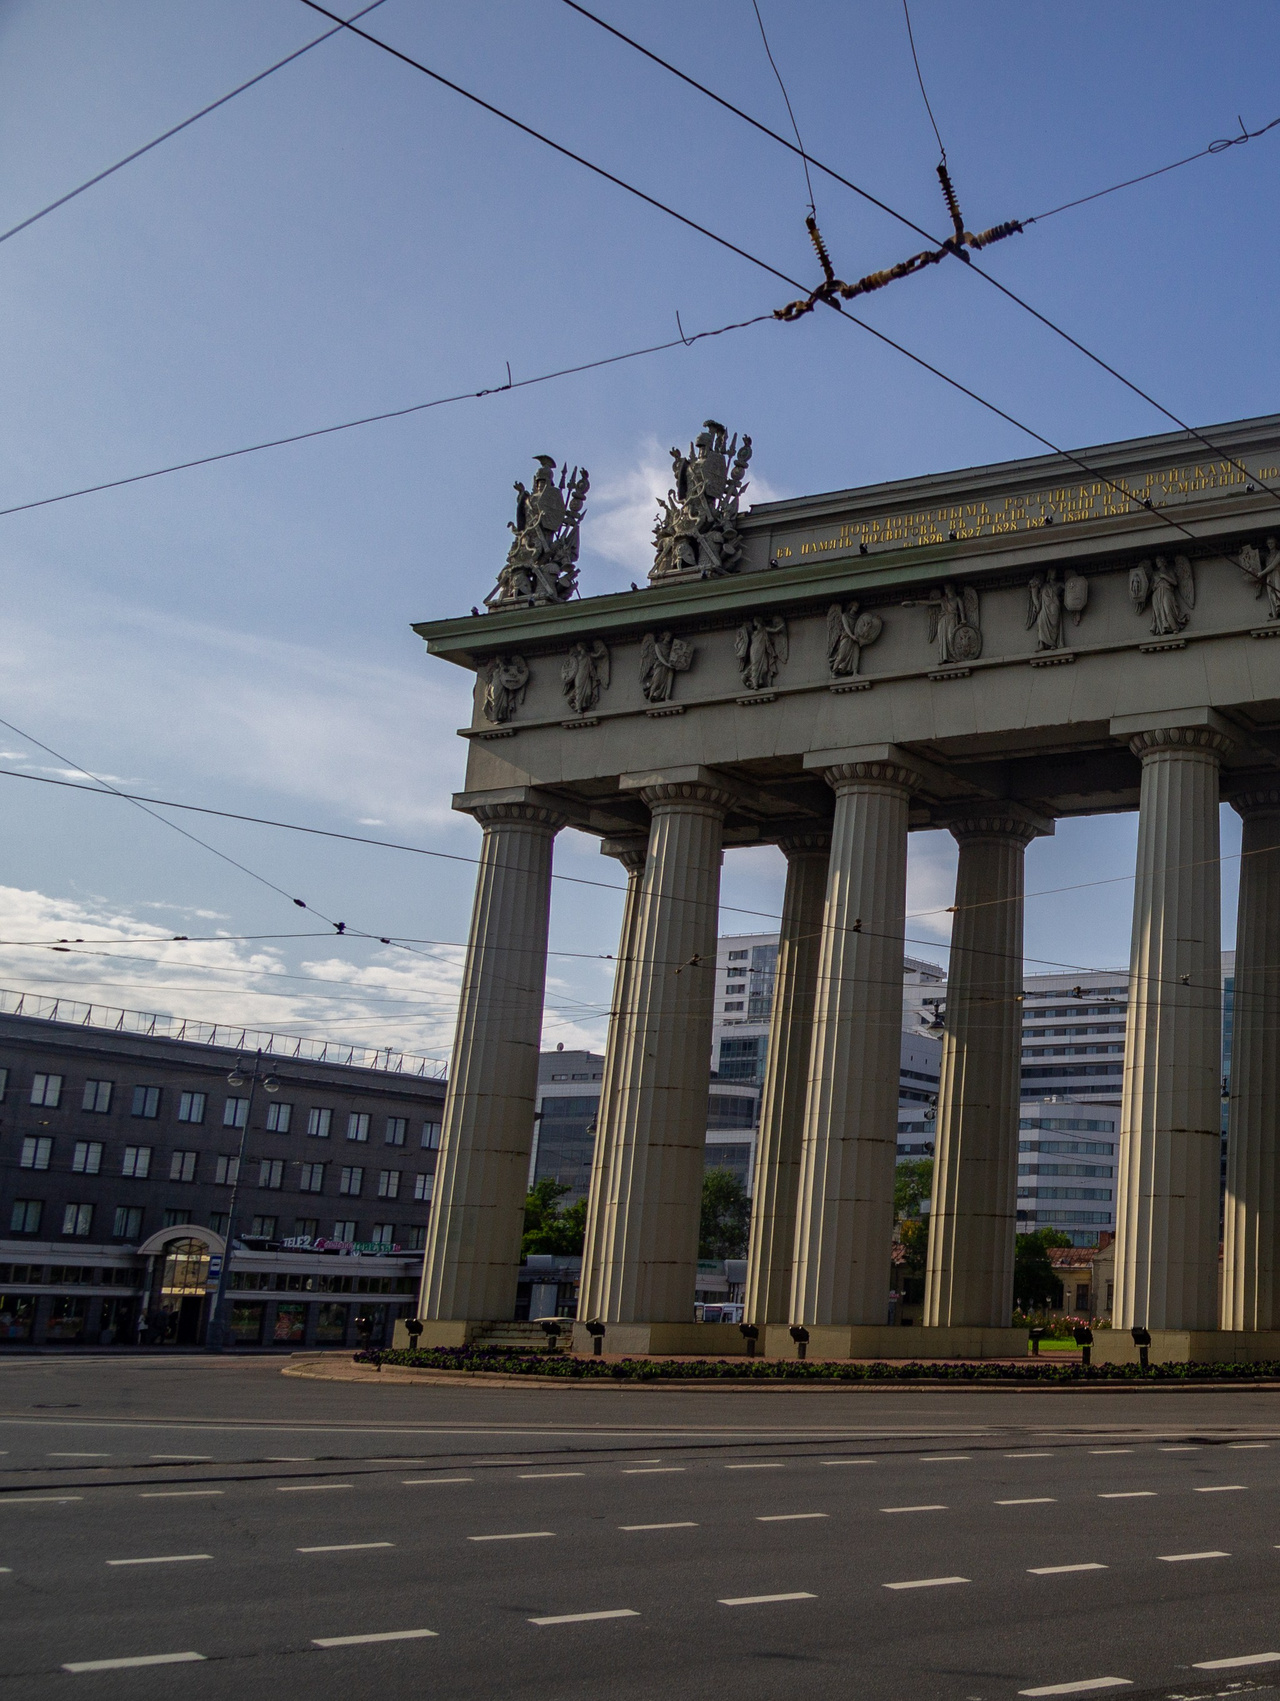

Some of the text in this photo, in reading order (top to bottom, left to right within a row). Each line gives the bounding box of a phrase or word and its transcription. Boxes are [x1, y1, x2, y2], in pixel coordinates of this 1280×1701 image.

[1145, 459, 1246, 487] ВОЙСКАМЪ
[776, 546, 792, 560] ВЪ
[949, 519, 966, 530] ВЪ
[283, 1235, 312, 1248] TELE2
